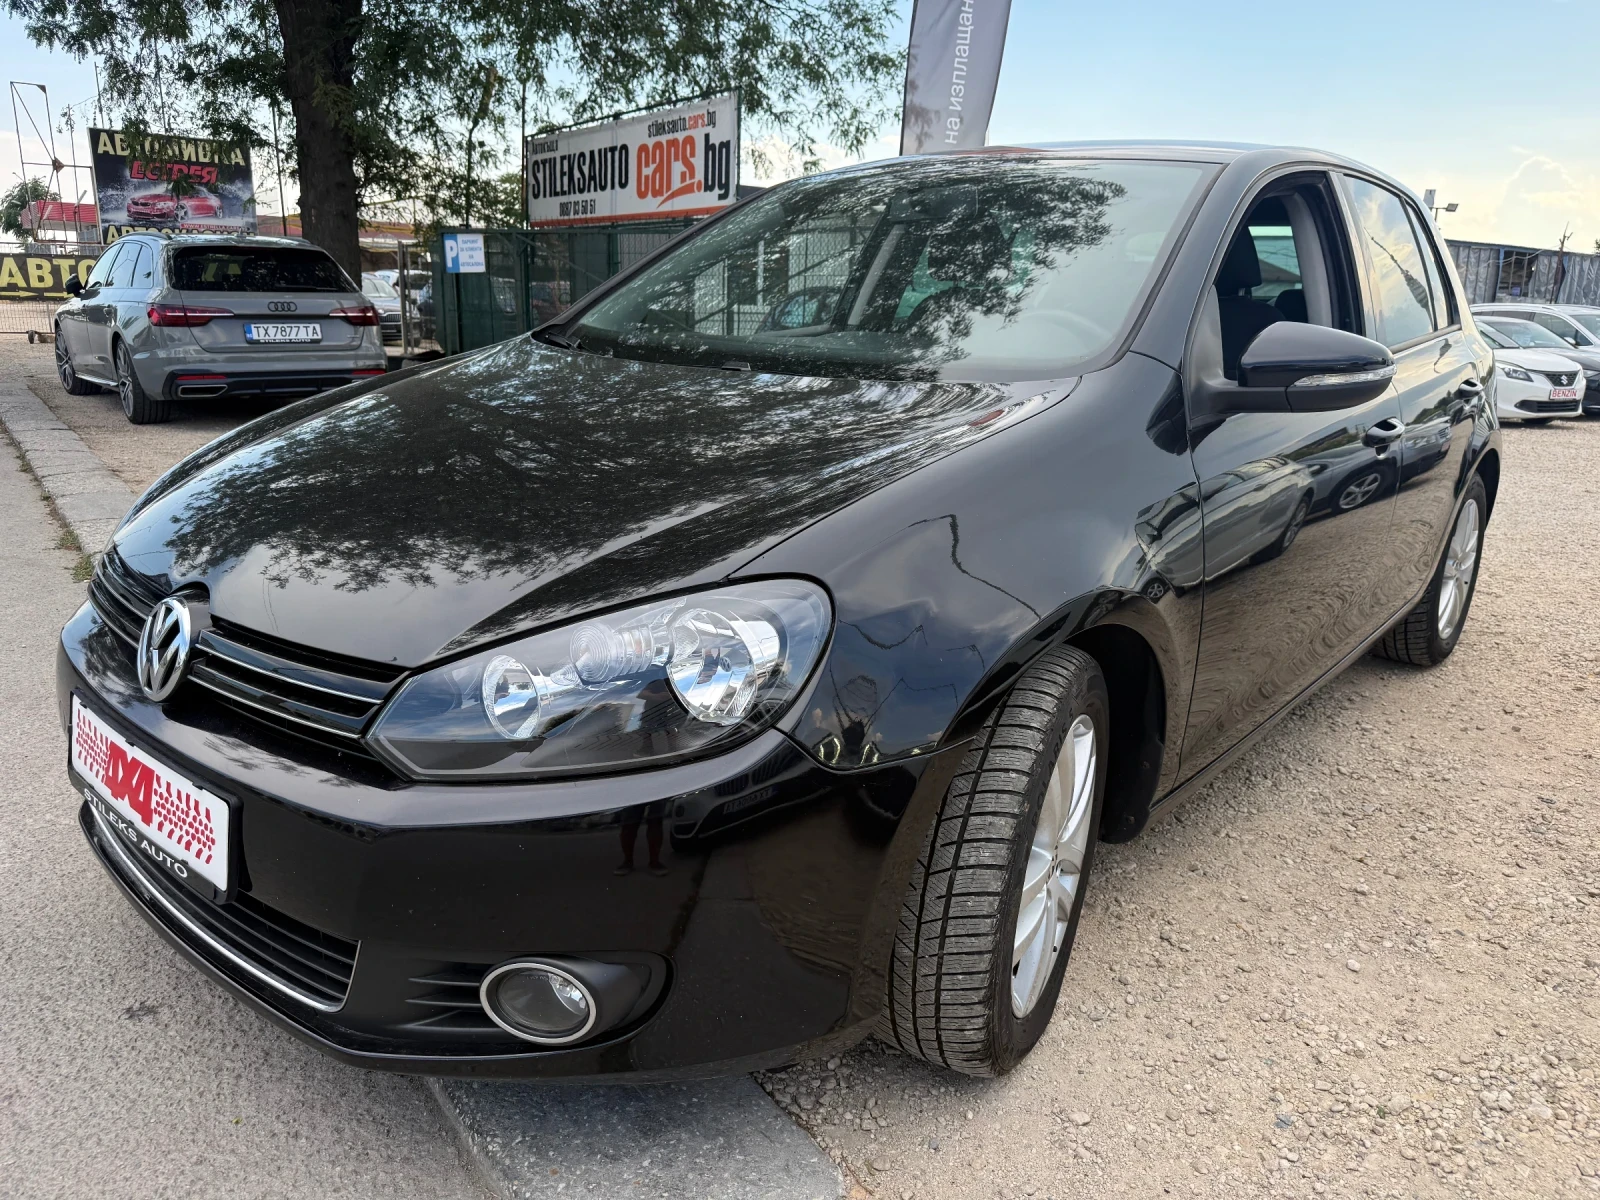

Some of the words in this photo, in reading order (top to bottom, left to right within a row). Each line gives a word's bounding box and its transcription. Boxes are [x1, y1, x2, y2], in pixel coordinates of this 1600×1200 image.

[647, 109, 717, 138] stileksauto.cars.bg
[945, 117, 961, 144] на
[532, 143, 629, 200] STILEKSAUTO
[581, 199, 589, 215] 50
[589, 198, 596, 215] 51
[1552, 389, 1577, 398] BENZIN
[84, 787, 138, 843] STILEKS
[140, 840, 188, 879] AUTO
